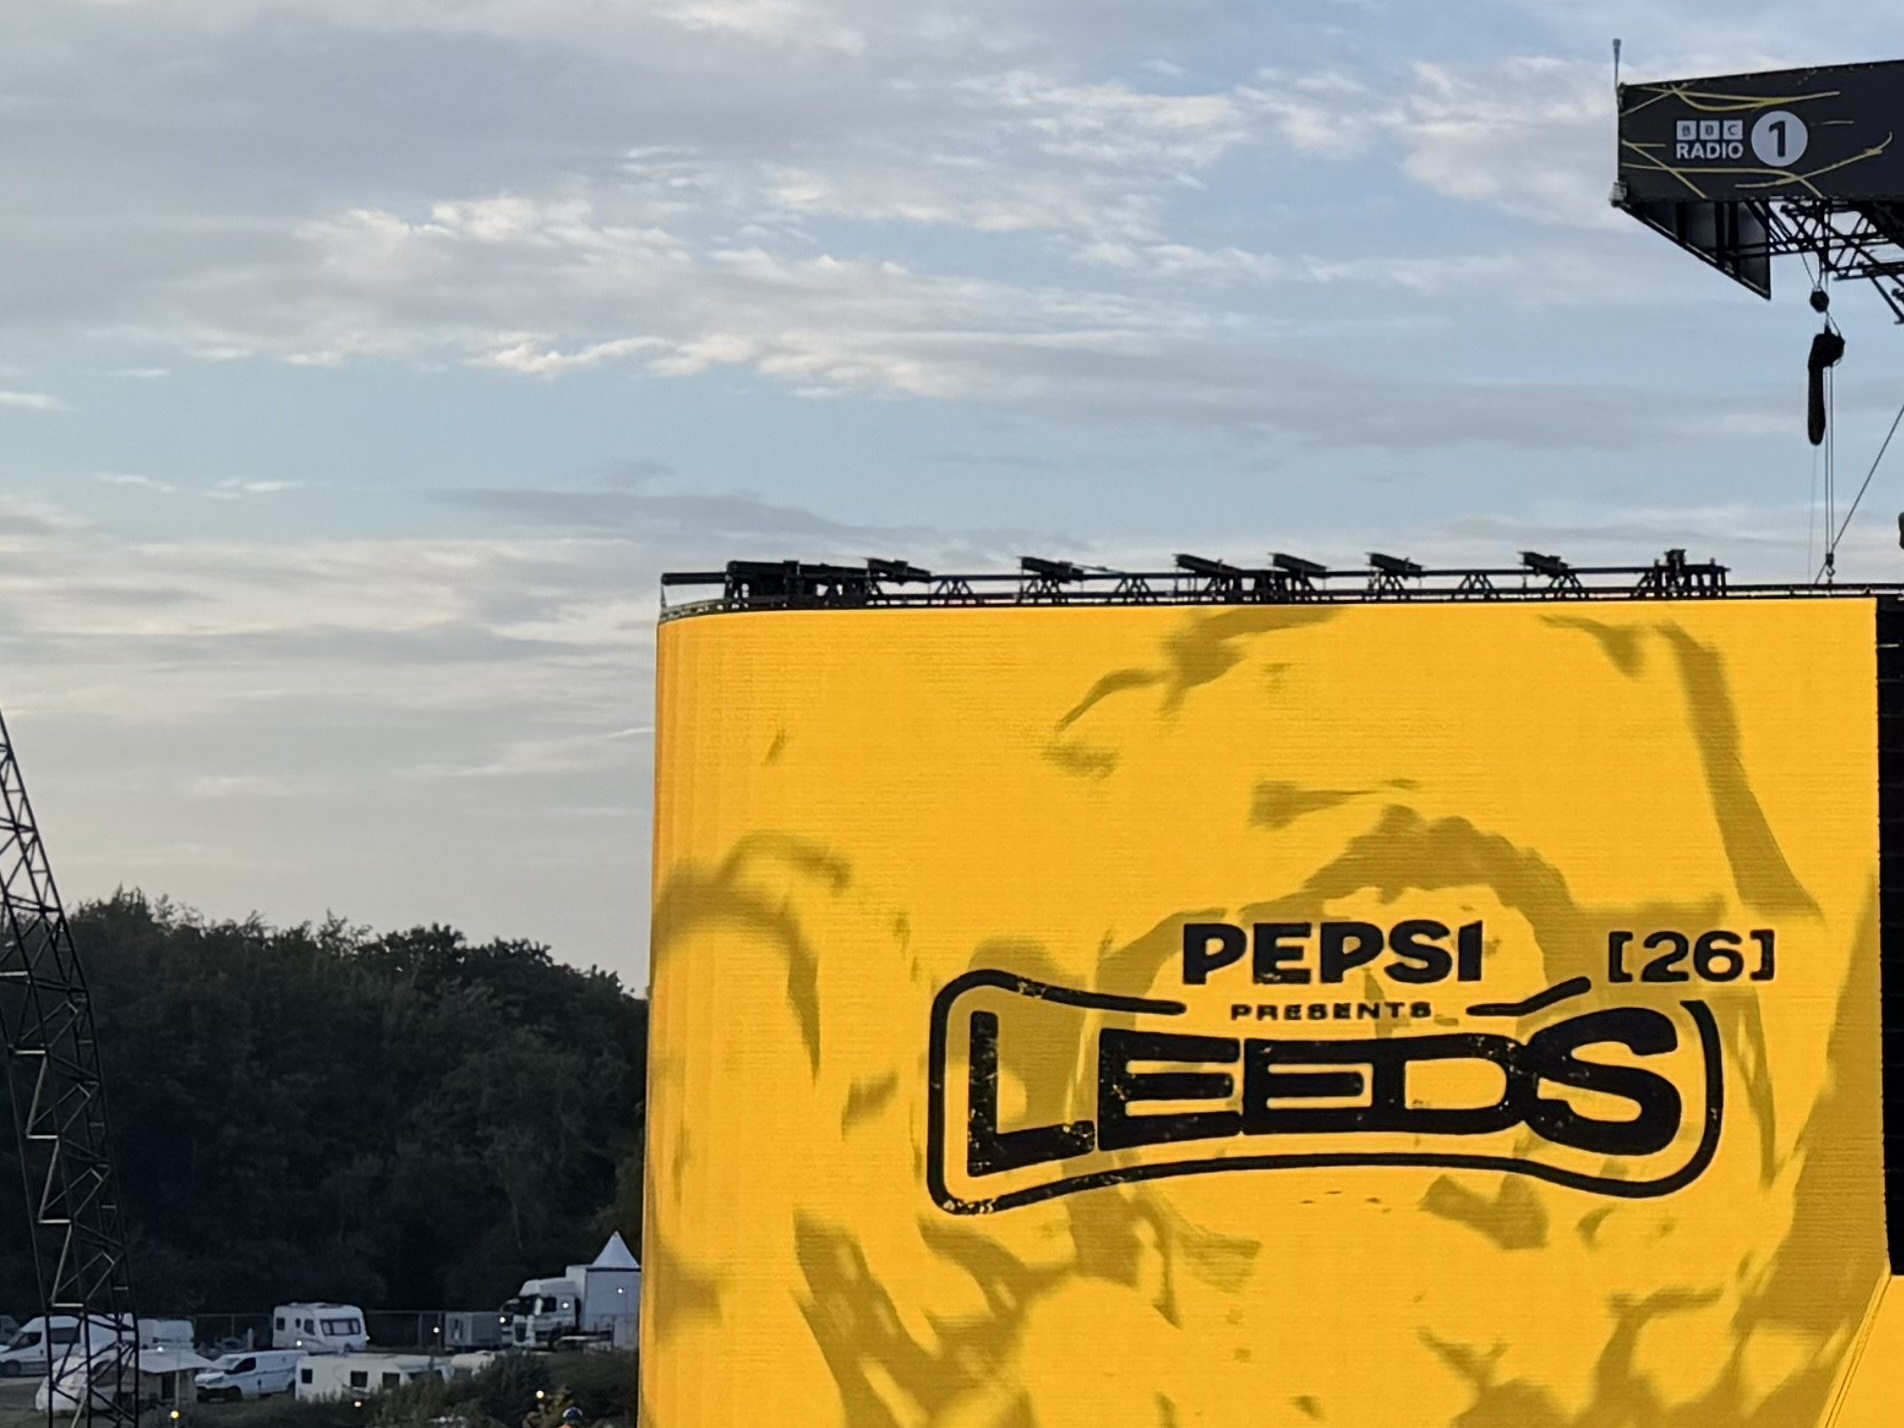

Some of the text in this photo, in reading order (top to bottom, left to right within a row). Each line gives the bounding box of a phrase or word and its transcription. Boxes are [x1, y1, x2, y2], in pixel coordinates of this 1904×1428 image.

[1676, 119, 1743, 140] BBC
[1676, 142, 1744, 159] RADIO
[1182, 920, 1484, 985] PEPSI
[1607, 929, 1776, 983] [26]
[1230, 1002, 1432, 1020] PRESENTS
[966, 1006, 1683, 1177] LEEDS
